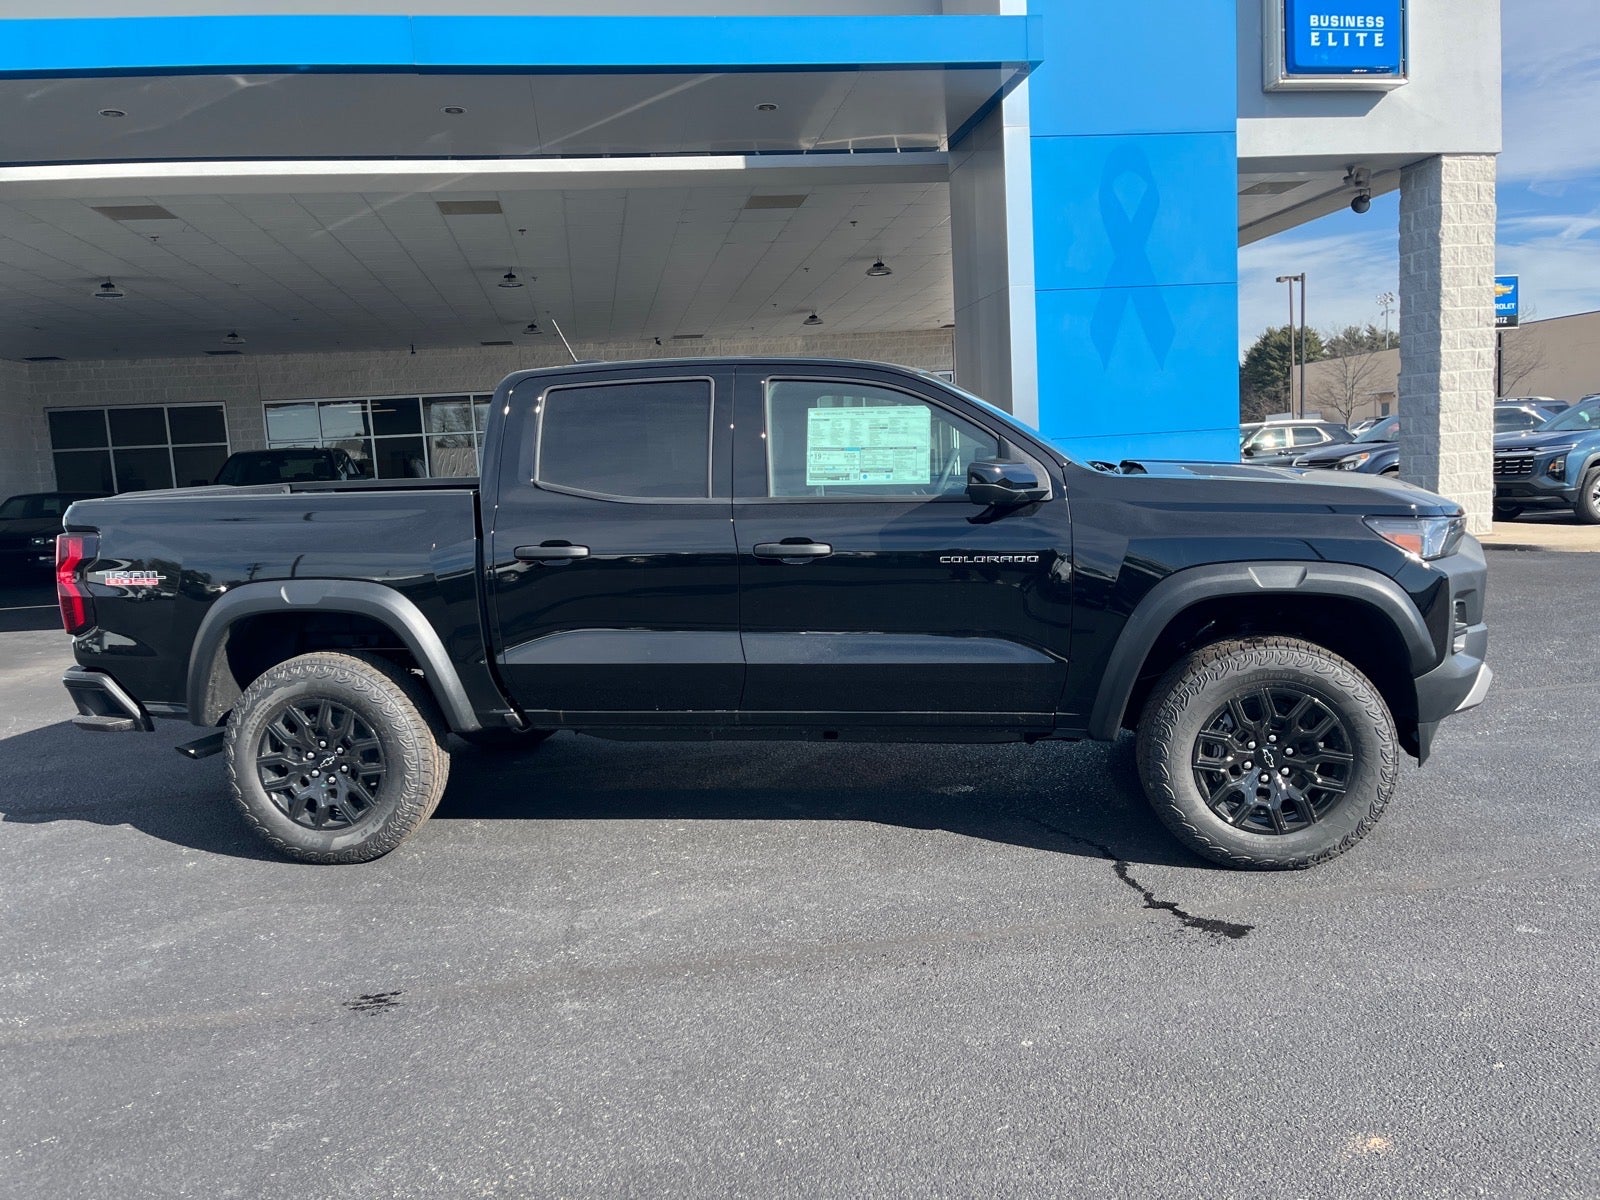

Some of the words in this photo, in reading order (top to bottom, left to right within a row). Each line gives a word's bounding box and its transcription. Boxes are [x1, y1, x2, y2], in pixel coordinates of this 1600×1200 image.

[1310, 15, 1384, 28] BUSINESS
[1310, 32, 1385, 47] ELITE
[939, 555, 1040, 564] COLORADO
[95, 570, 167, 580] TRAIL
[105, 578, 159, 586] BOSS
